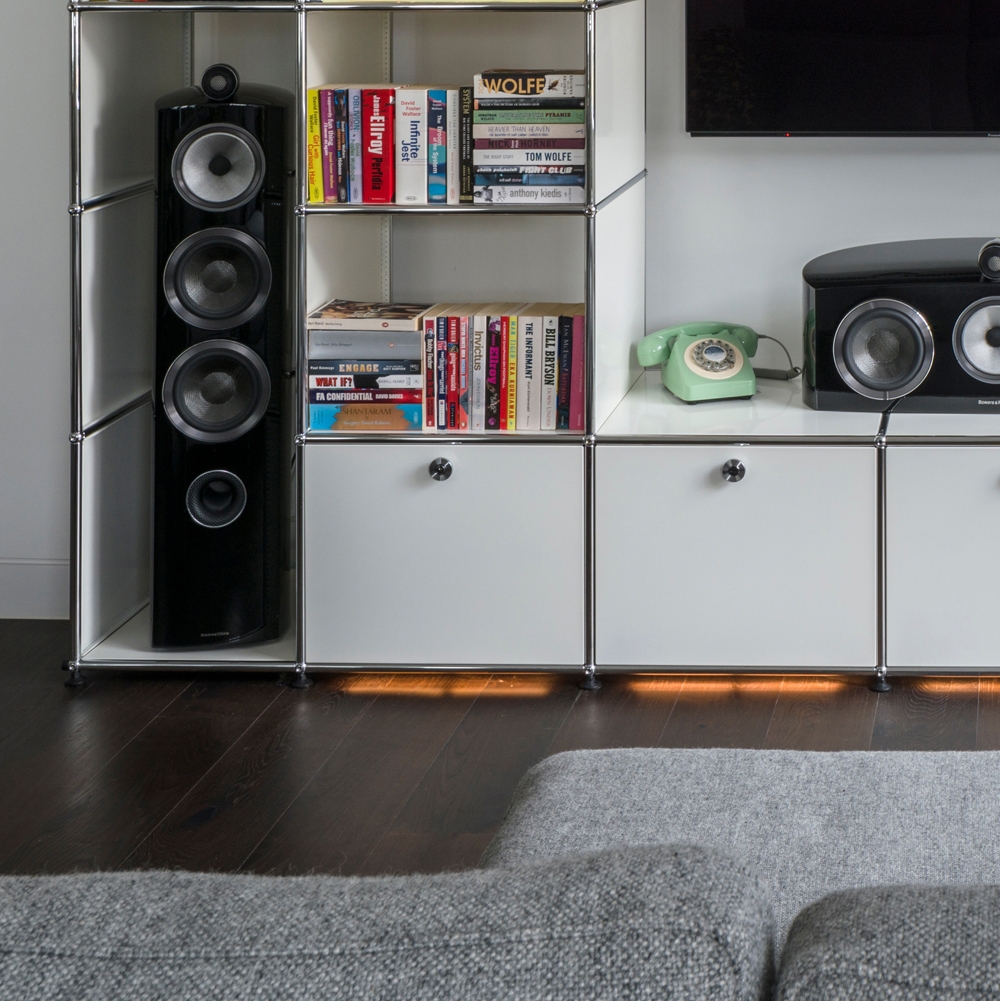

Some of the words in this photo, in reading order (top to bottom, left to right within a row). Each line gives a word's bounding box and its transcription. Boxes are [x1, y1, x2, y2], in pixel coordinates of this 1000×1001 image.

[485, 78, 546, 94] WOLFE
[372, 95, 380, 116] James
[368, 116, 385, 155] Ellroy
[410, 120, 420, 158] Infinite
[401, 140, 411, 162] Jest
[525, 152, 541, 162] TOM
[543, 152, 572, 161] WOLFE
[519, 166, 546, 174] FIGHT
[509, 188, 539, 199] anthony
[540, 188, 562, 198] kiedis
[525, 323, 533, 336] THE
[545, 328, 555, 349] BILL
[474, 331, 484, 371] Invictus
[525, 337, 533, 380] INFORMANT
[339, 364, 379, 373] ENGAGE
[509, 362, 517, 376] EKA
[544, 350, 555, 385] BRYSON
[315, 377, 338, 387] WHAT
[340, 377, 353, 387] IF?
[316, 392, 325, 401] FA
[326, 392, 373, 401] CONFIDENTIAL
[509, 379, 517, 419] KURNIAWAN
